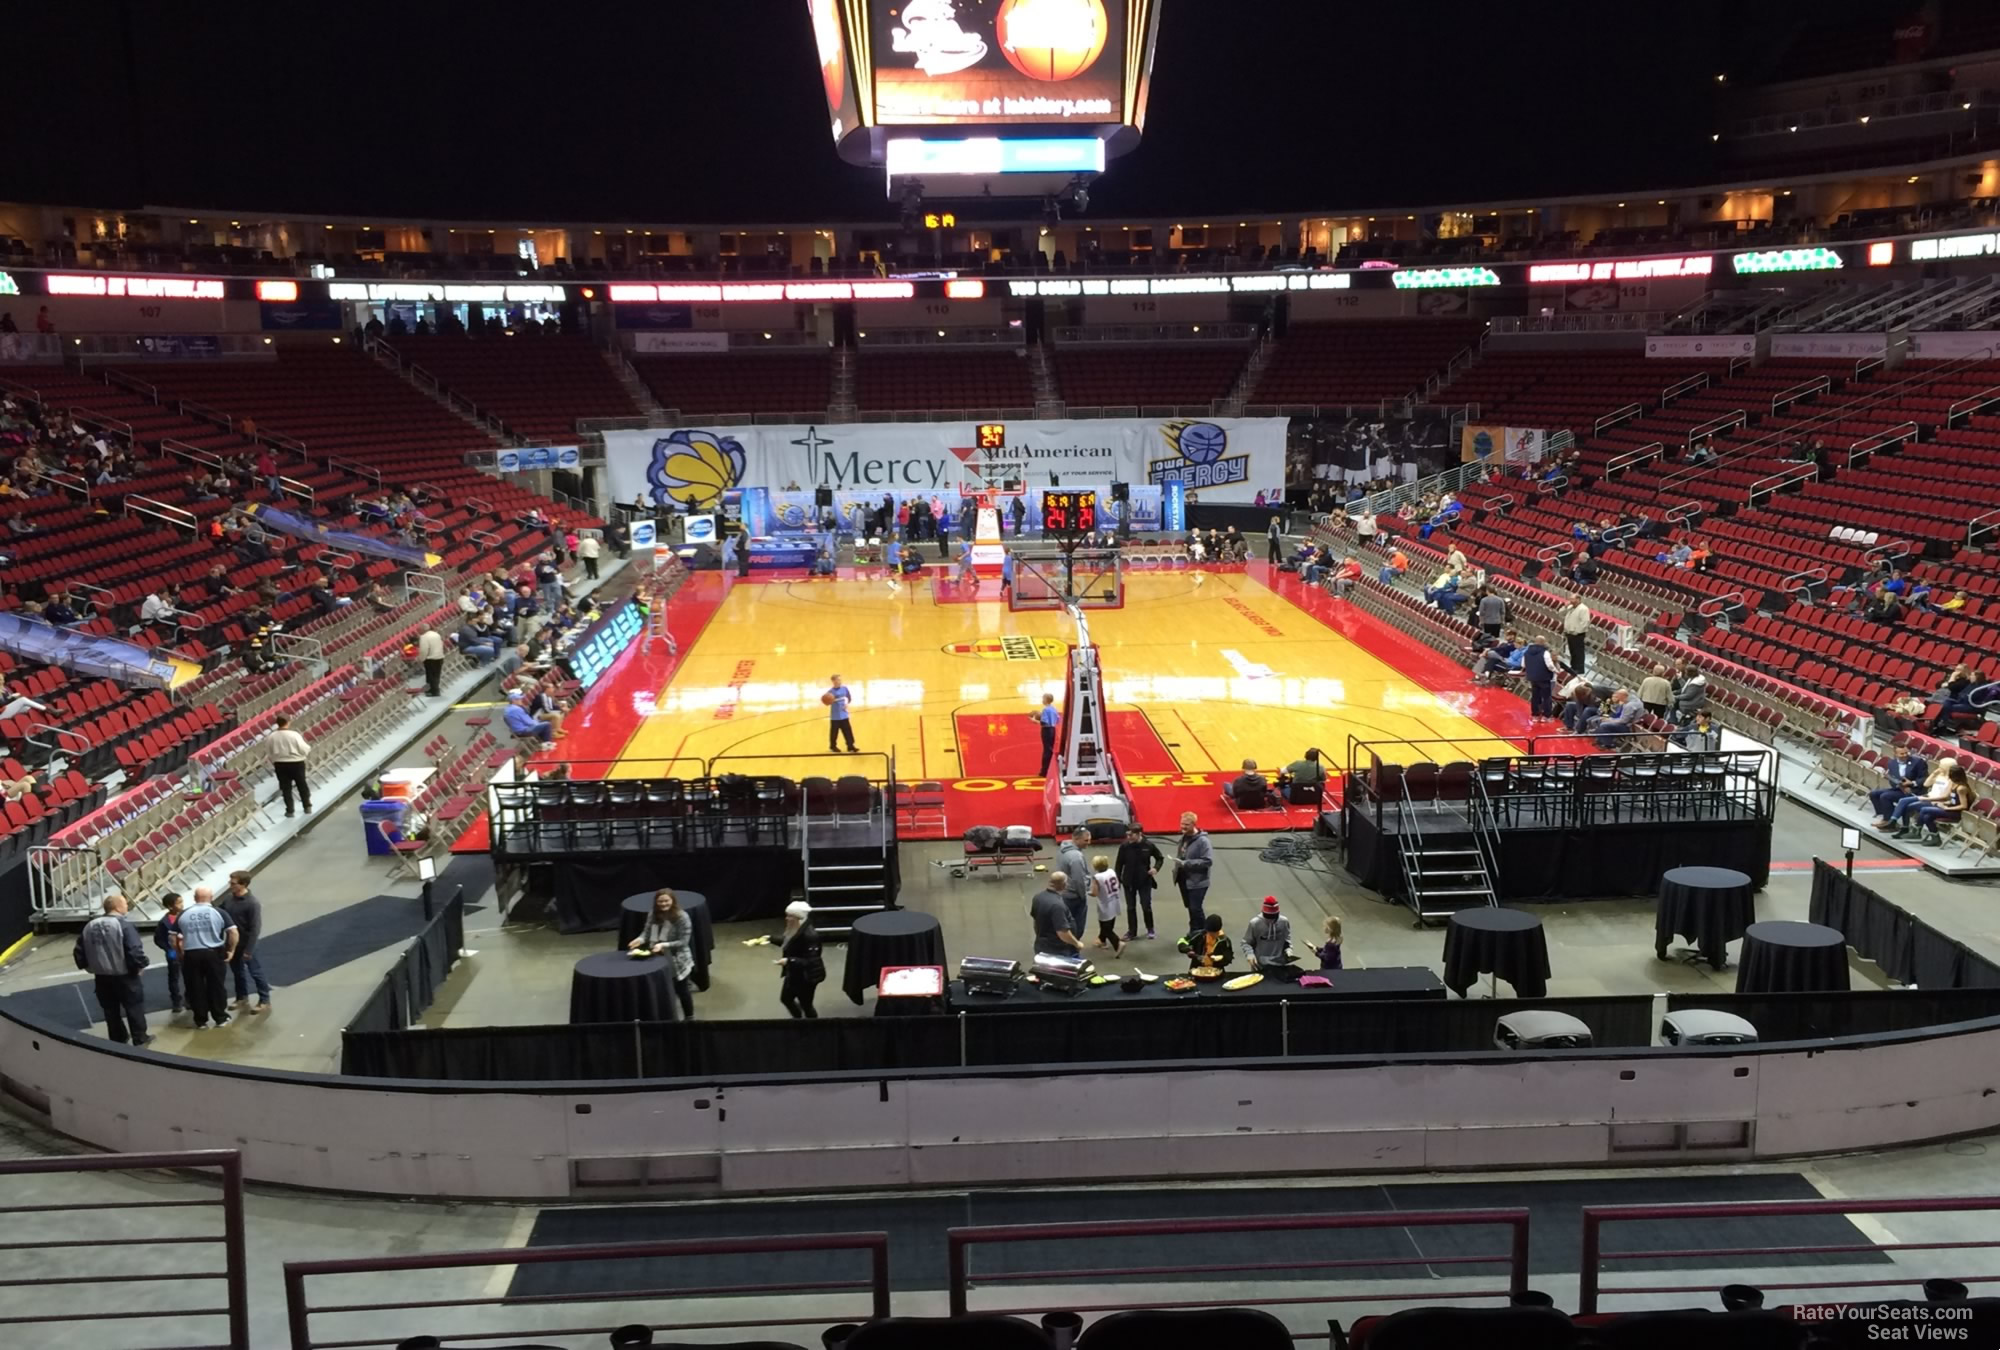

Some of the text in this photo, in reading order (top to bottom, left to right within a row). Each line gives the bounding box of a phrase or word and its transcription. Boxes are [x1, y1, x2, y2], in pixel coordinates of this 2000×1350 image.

[1621, 286, 1647, 297] 113
[139, 306, 161, 318] 107
[1132, 301, 1156, 312] 112
[982, 434, 999, 446] 24
[824, 451, 945, 489] Mercy
[1152, 458, 1185, 471] IOWA
[1171, 485, 1180, 531] ROCKSTAR
[1047, 507, 1065, 528] 24
[1079, 508, 1094, 529] 24
[1104, 876, 1118, 895] 12
[189, 912, 210, 921] CSC
